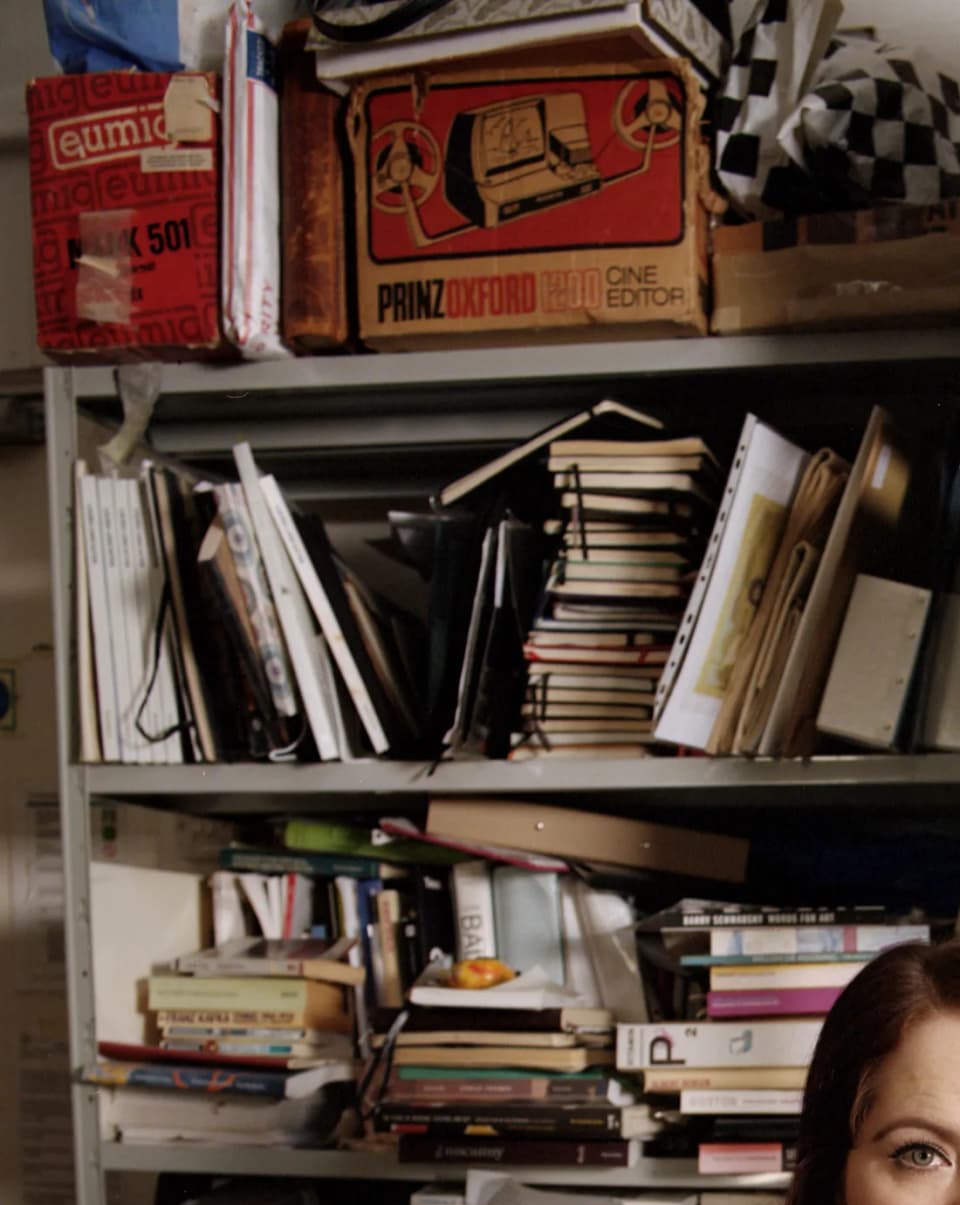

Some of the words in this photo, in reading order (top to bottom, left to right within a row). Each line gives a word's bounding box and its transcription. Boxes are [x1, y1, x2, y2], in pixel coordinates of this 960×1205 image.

[147, 216, 191, 256] 501
[377, 278, 445, 324] PRINZ
[445, 271, 538, 320] OXFORD
[605, 265, 659, 287] CINE
[606, 286, 687, 309] EDITOR
